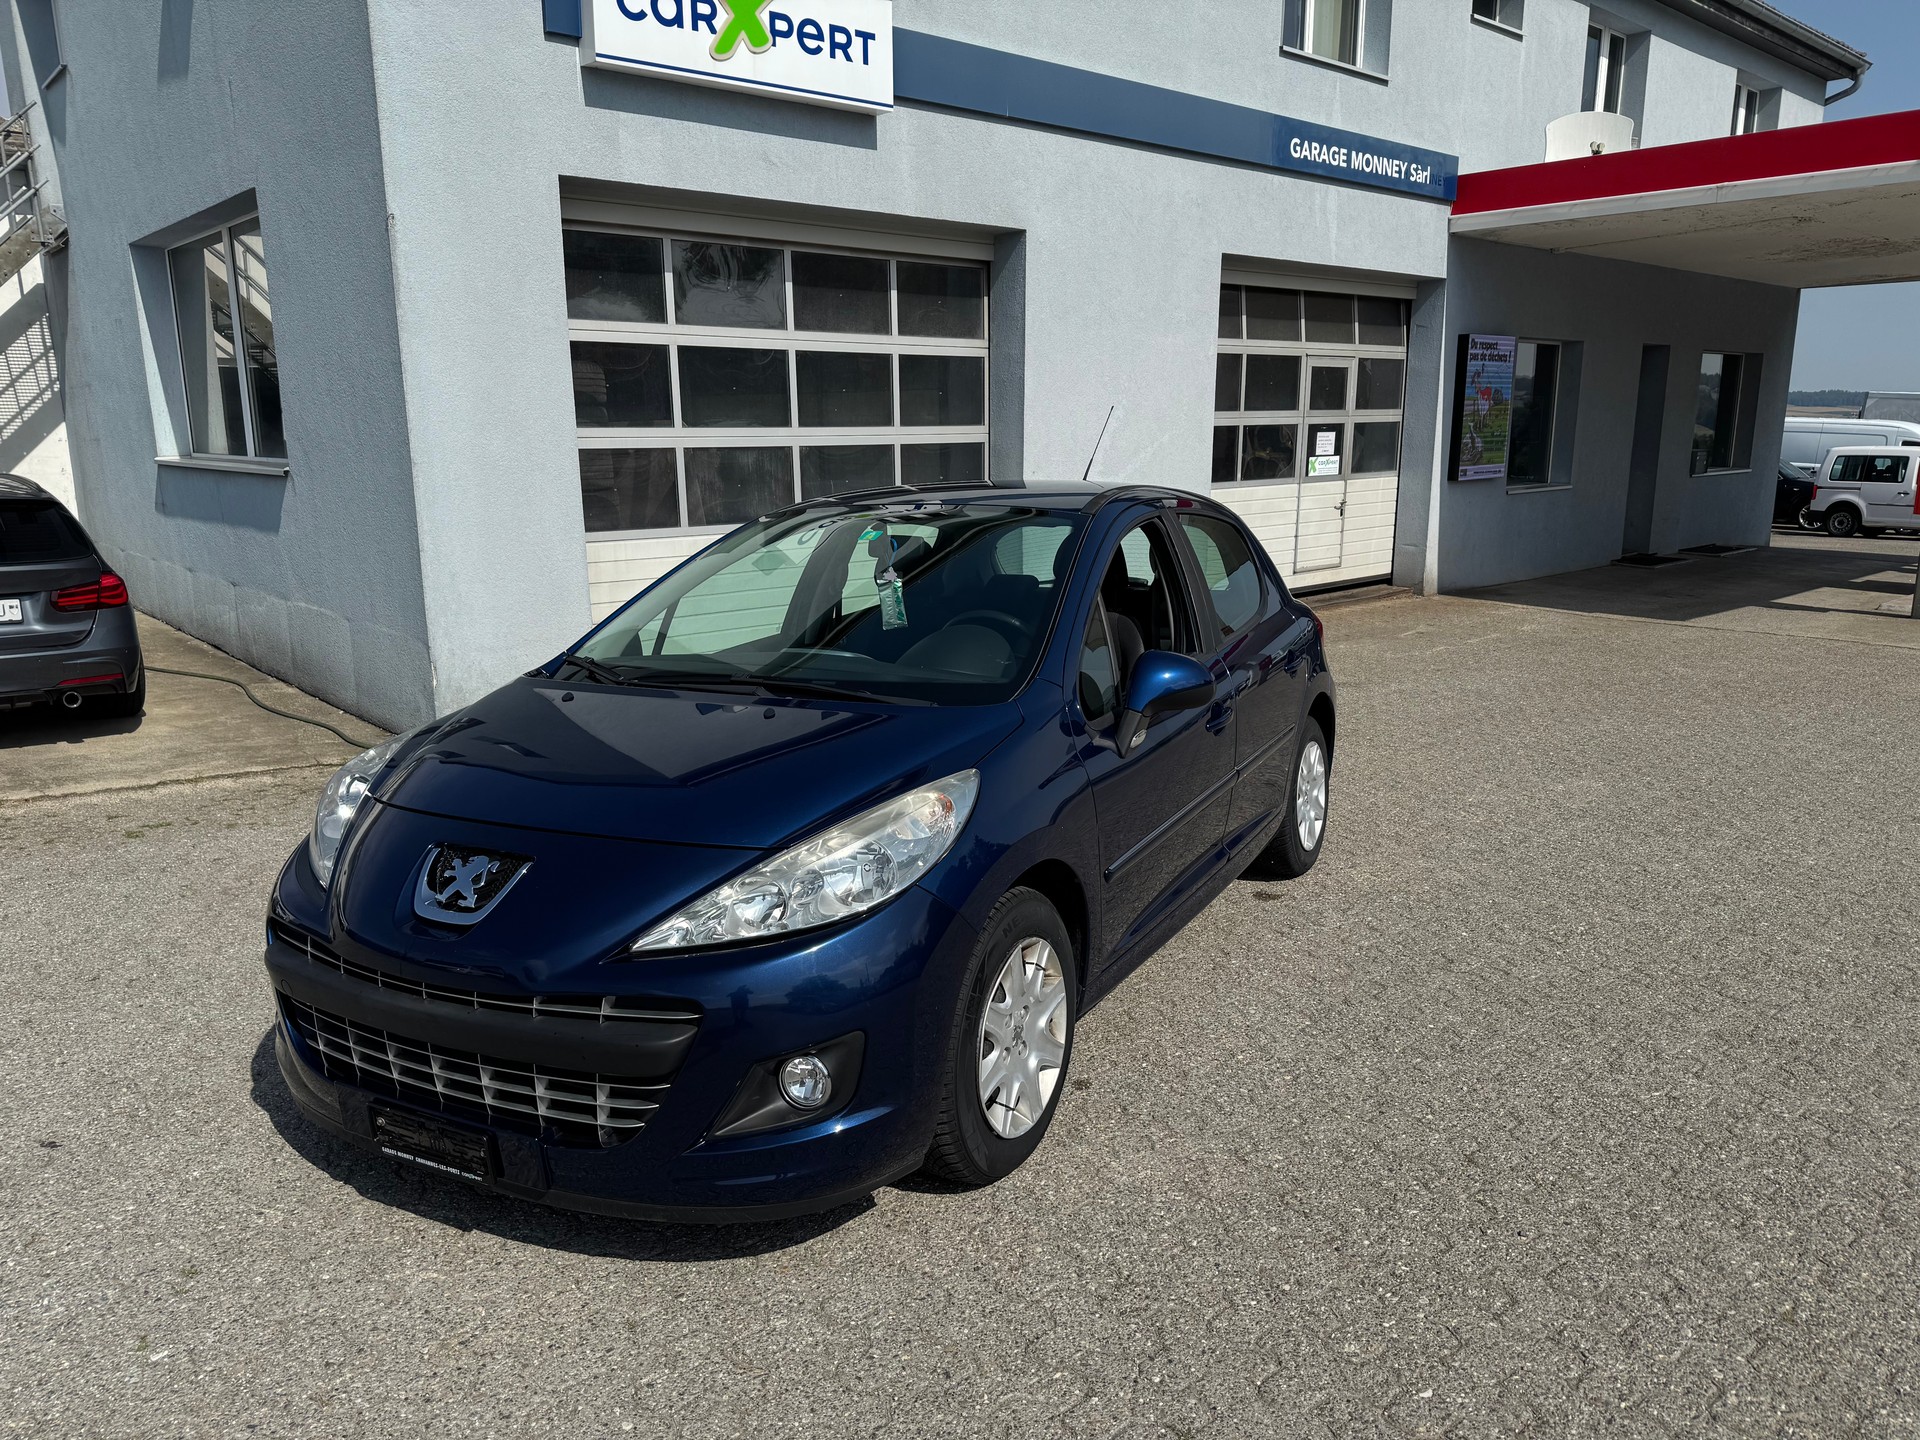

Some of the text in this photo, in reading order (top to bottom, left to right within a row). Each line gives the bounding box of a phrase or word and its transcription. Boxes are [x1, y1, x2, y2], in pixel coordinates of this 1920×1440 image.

[1290, 138, 1430, 185] GARAGE MONNEY Sàrl
[1479, 341, 1498, 351] respect
[1470, 353, 1479, 362] pas
[1480, 351, 1487, 361] de
